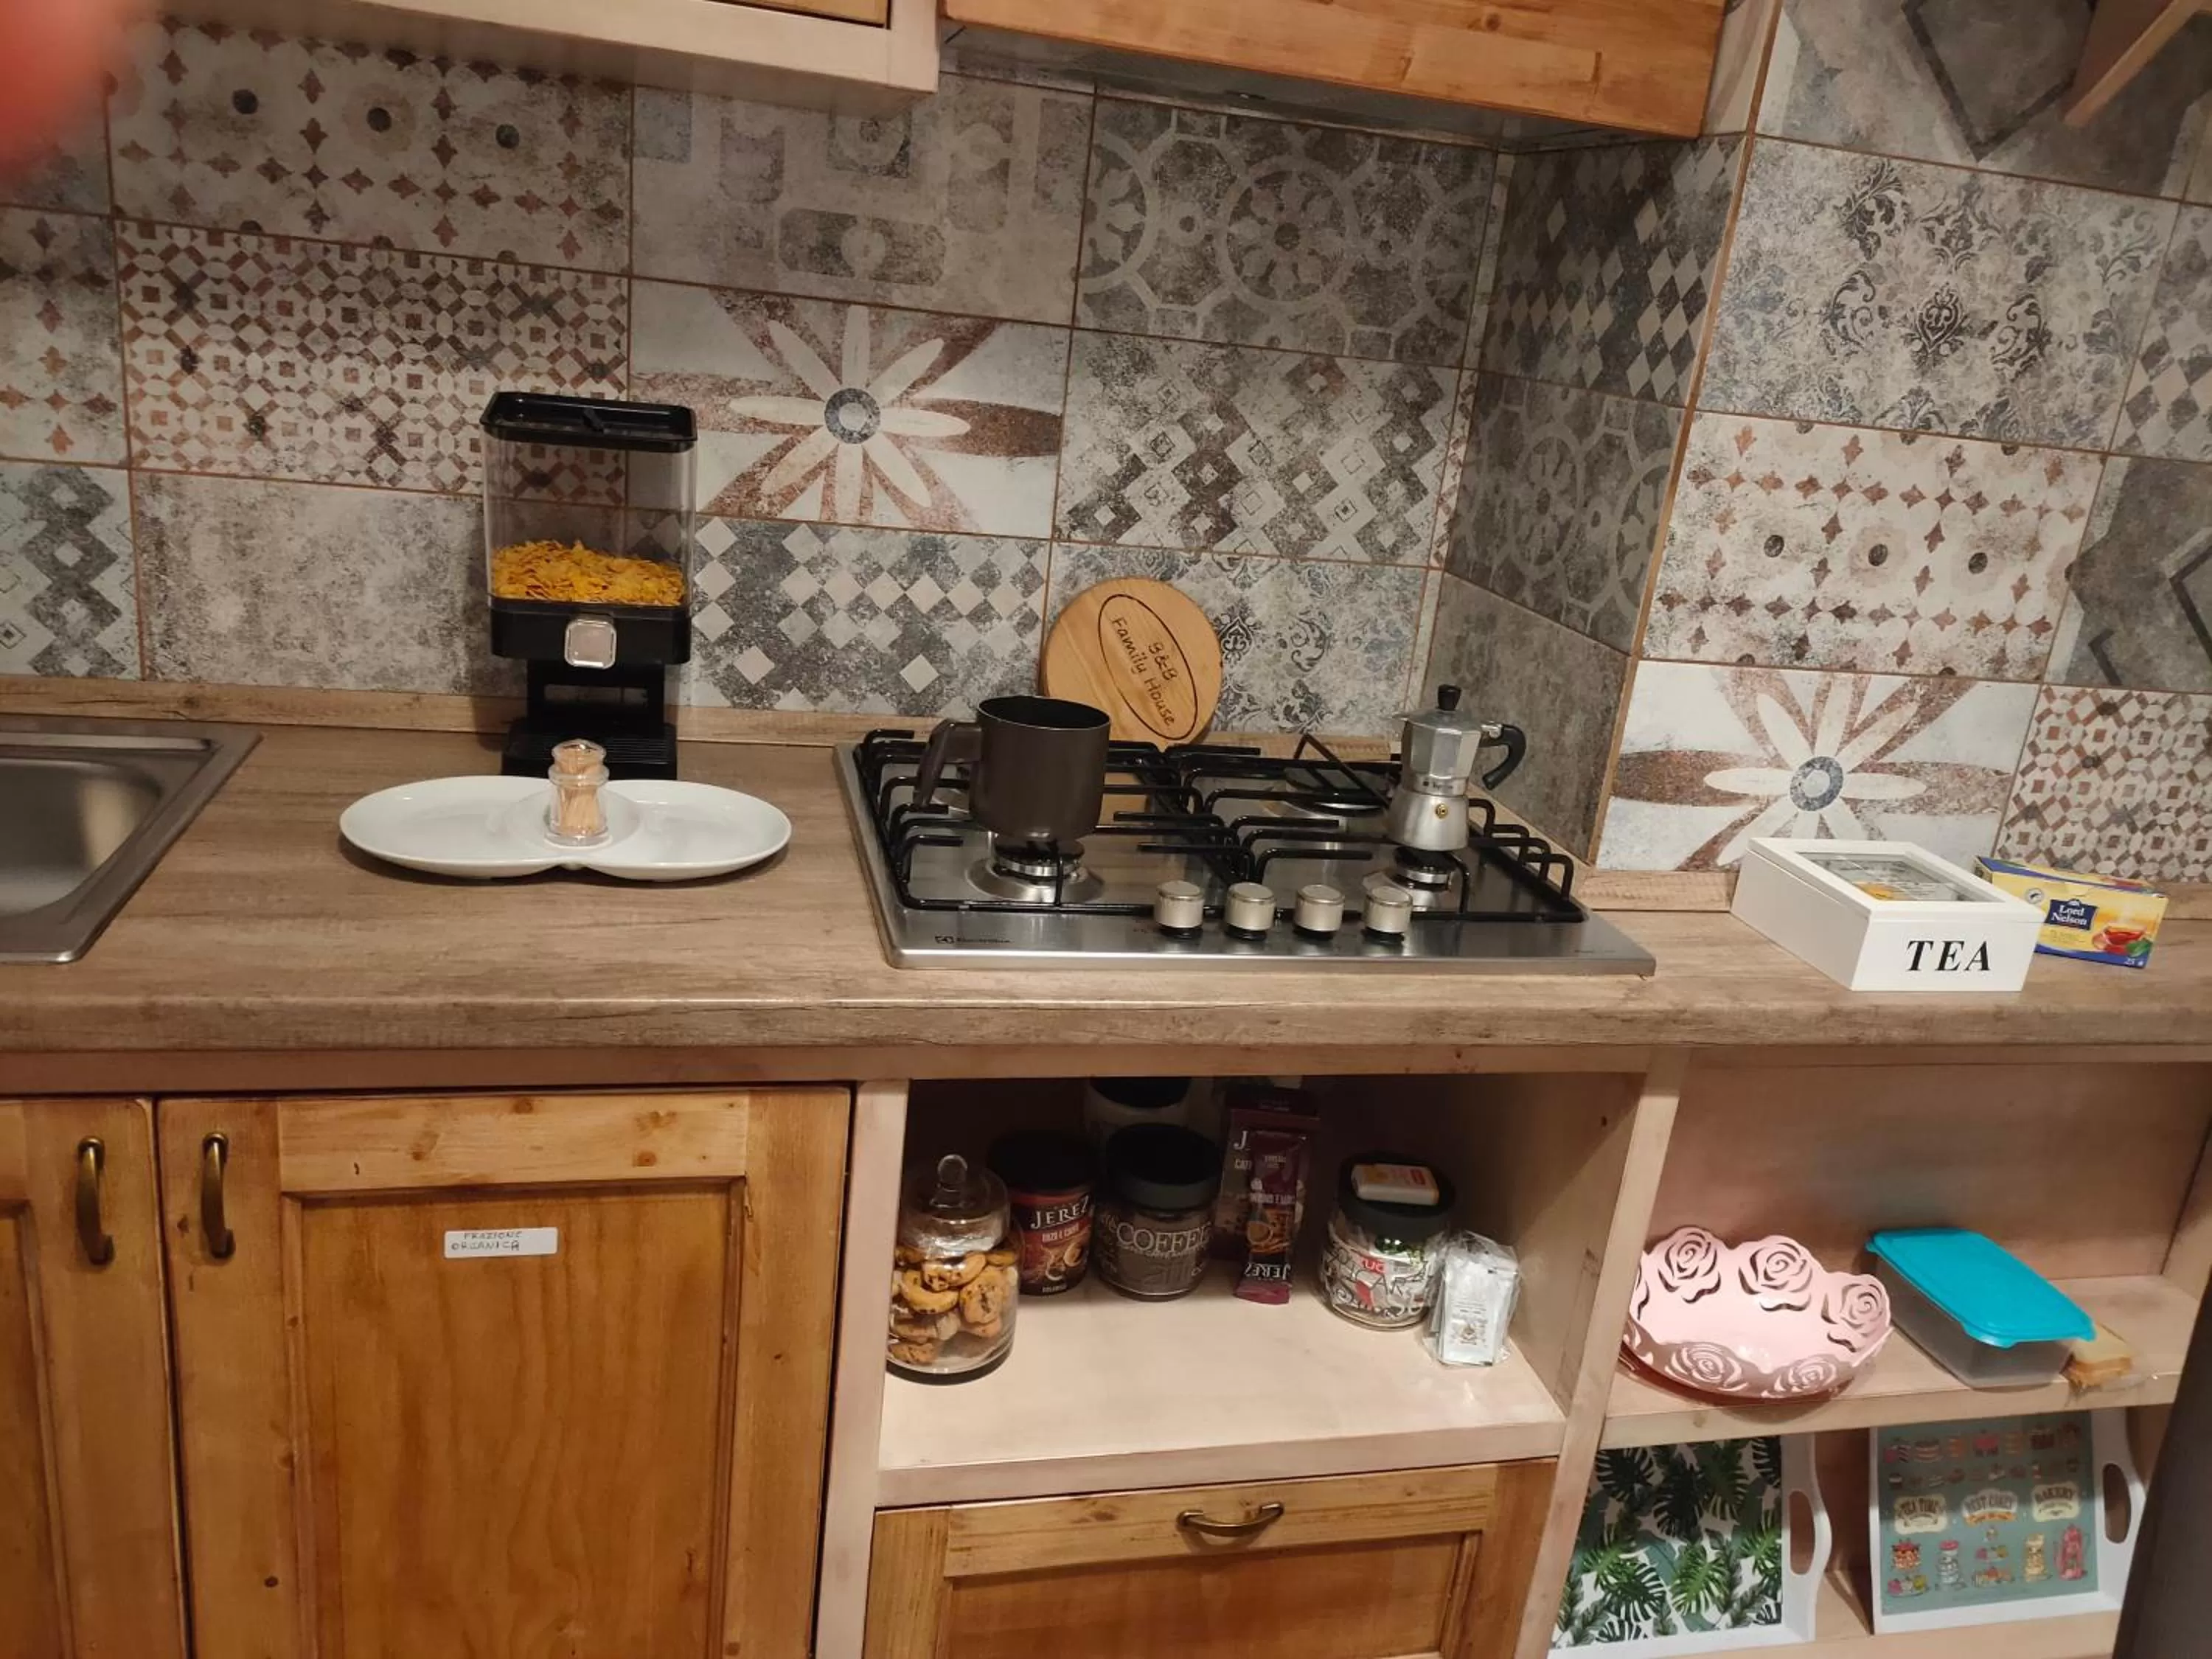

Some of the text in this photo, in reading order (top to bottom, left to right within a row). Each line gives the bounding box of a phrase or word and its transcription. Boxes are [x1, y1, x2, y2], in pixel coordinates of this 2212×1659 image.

[1111, 615, 1175, 726] Family House
[2051, 912, 2088, 926] Nelson
[2059, 905, 2085, 916] Lord
[1906, 939, 1992, 972] TEA
[1030, 1194, 1090, 1230] JEREZ
[1116, 1222, 1211, 1253] COFFEE
[1244, 1262, 1292, 1281] JEREZ
